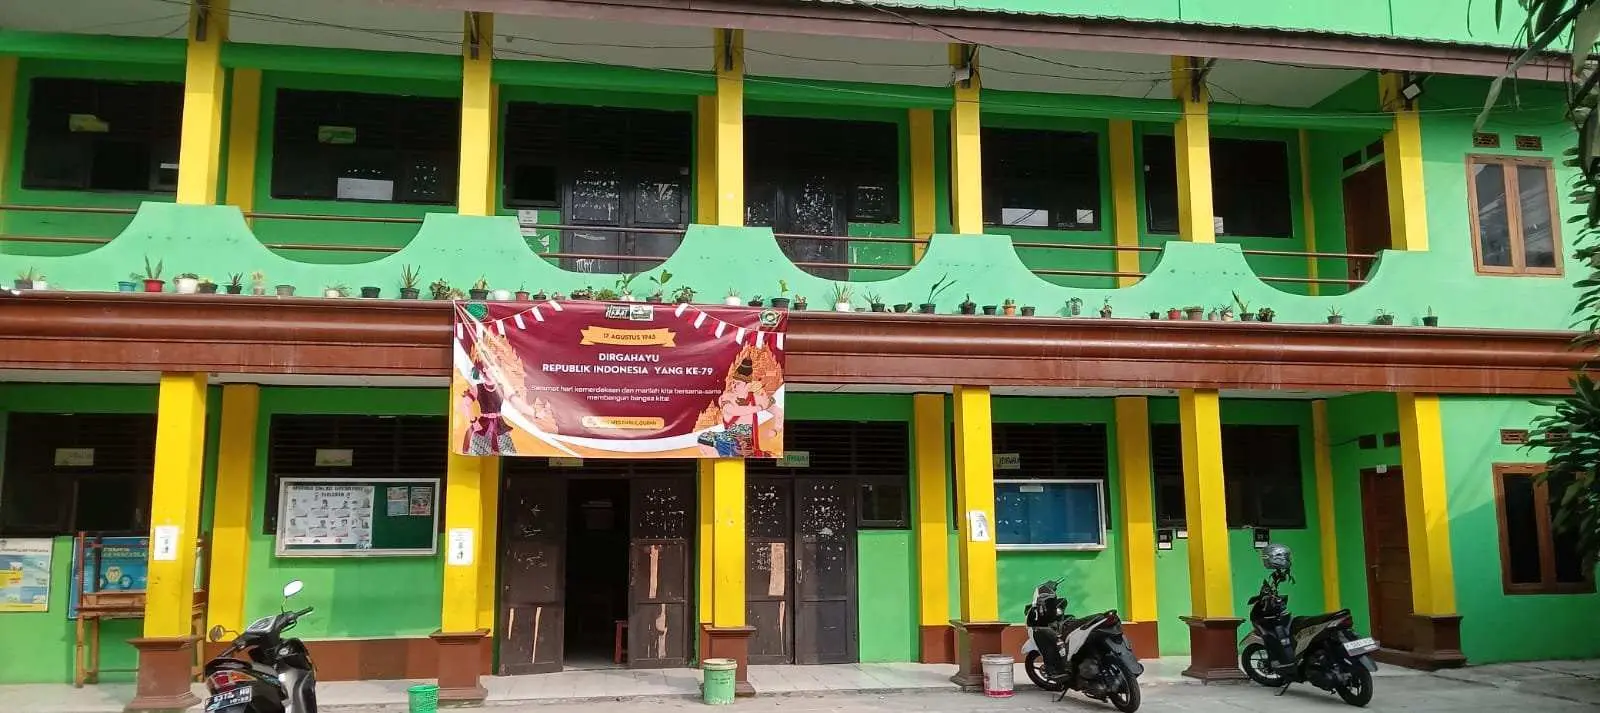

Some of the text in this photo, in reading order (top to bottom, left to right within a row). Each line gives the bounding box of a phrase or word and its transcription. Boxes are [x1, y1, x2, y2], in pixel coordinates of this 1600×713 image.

[610, 333, 641, 341] AGUSTUS
[642, 333, 656, 341] 1945
[598, 353, 660, 362] DIRGAHAYU
[542, 363, 713, 376] REPUBLIK INDONESIA YANG KE-79
[561, 384, 574, 393] hari
[621, 386, 635, 394] dan
[660, 387, 674, 395] kita
[674, 387, 722, 396] bersama-sama
[586, 394, 630, 403] membangun
[630, 394, 655, 403] bangsa
